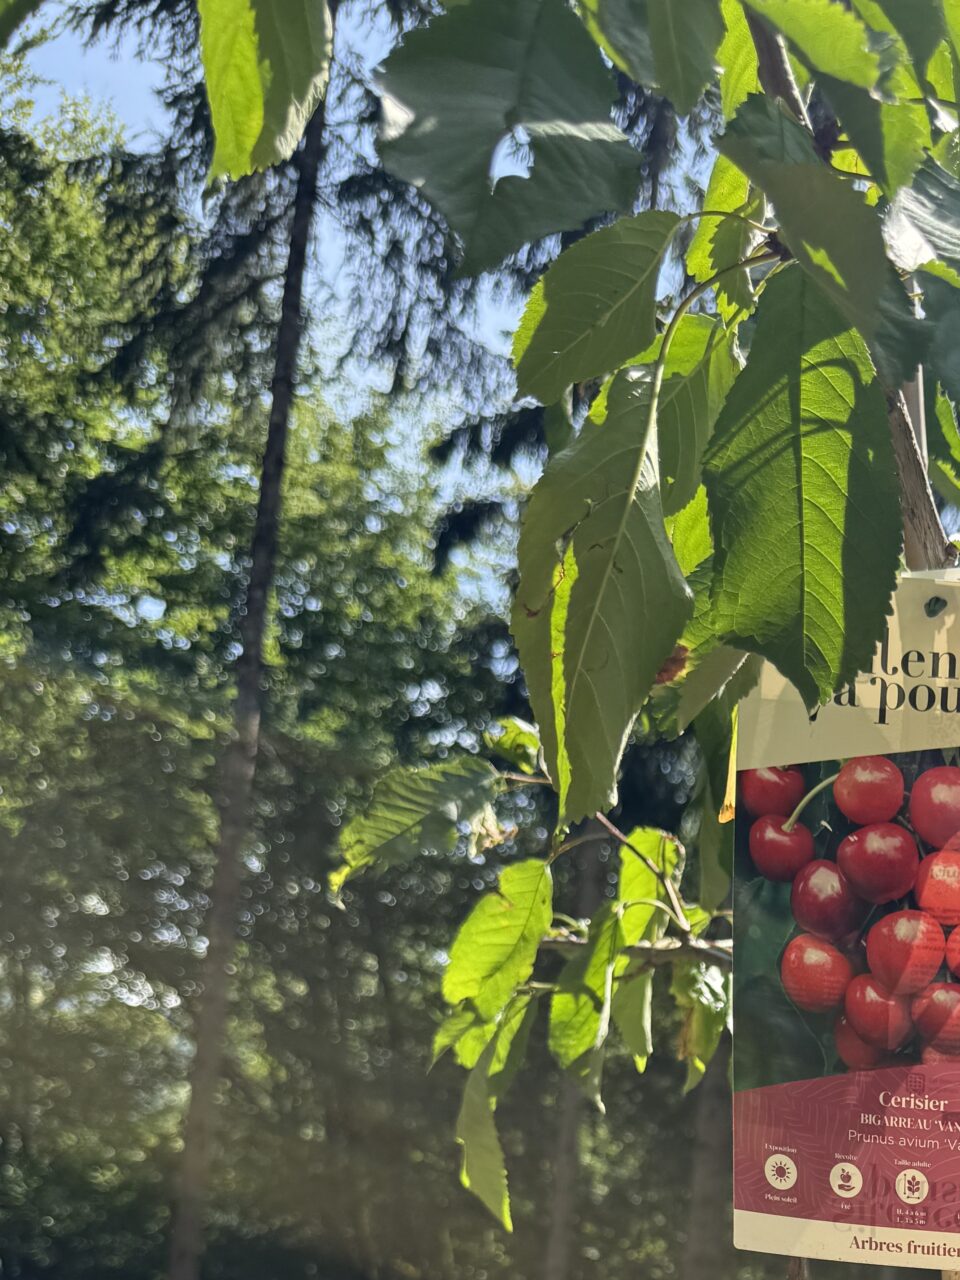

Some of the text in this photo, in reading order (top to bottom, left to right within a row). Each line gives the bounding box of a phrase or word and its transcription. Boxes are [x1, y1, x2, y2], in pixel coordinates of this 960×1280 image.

[878, 1090, 949, 1112] Cerisier
[859, 1113, 932, 1131] BIGARREAU
[765, 1143, 797, 1153] Exposition
[848, 1130, 894, 1146] Prunus
[898, 1135, 940, 1149] avium
[912, 1160, 932, 1168] adulte
[849, 1236, 903, 1254] Arbres
